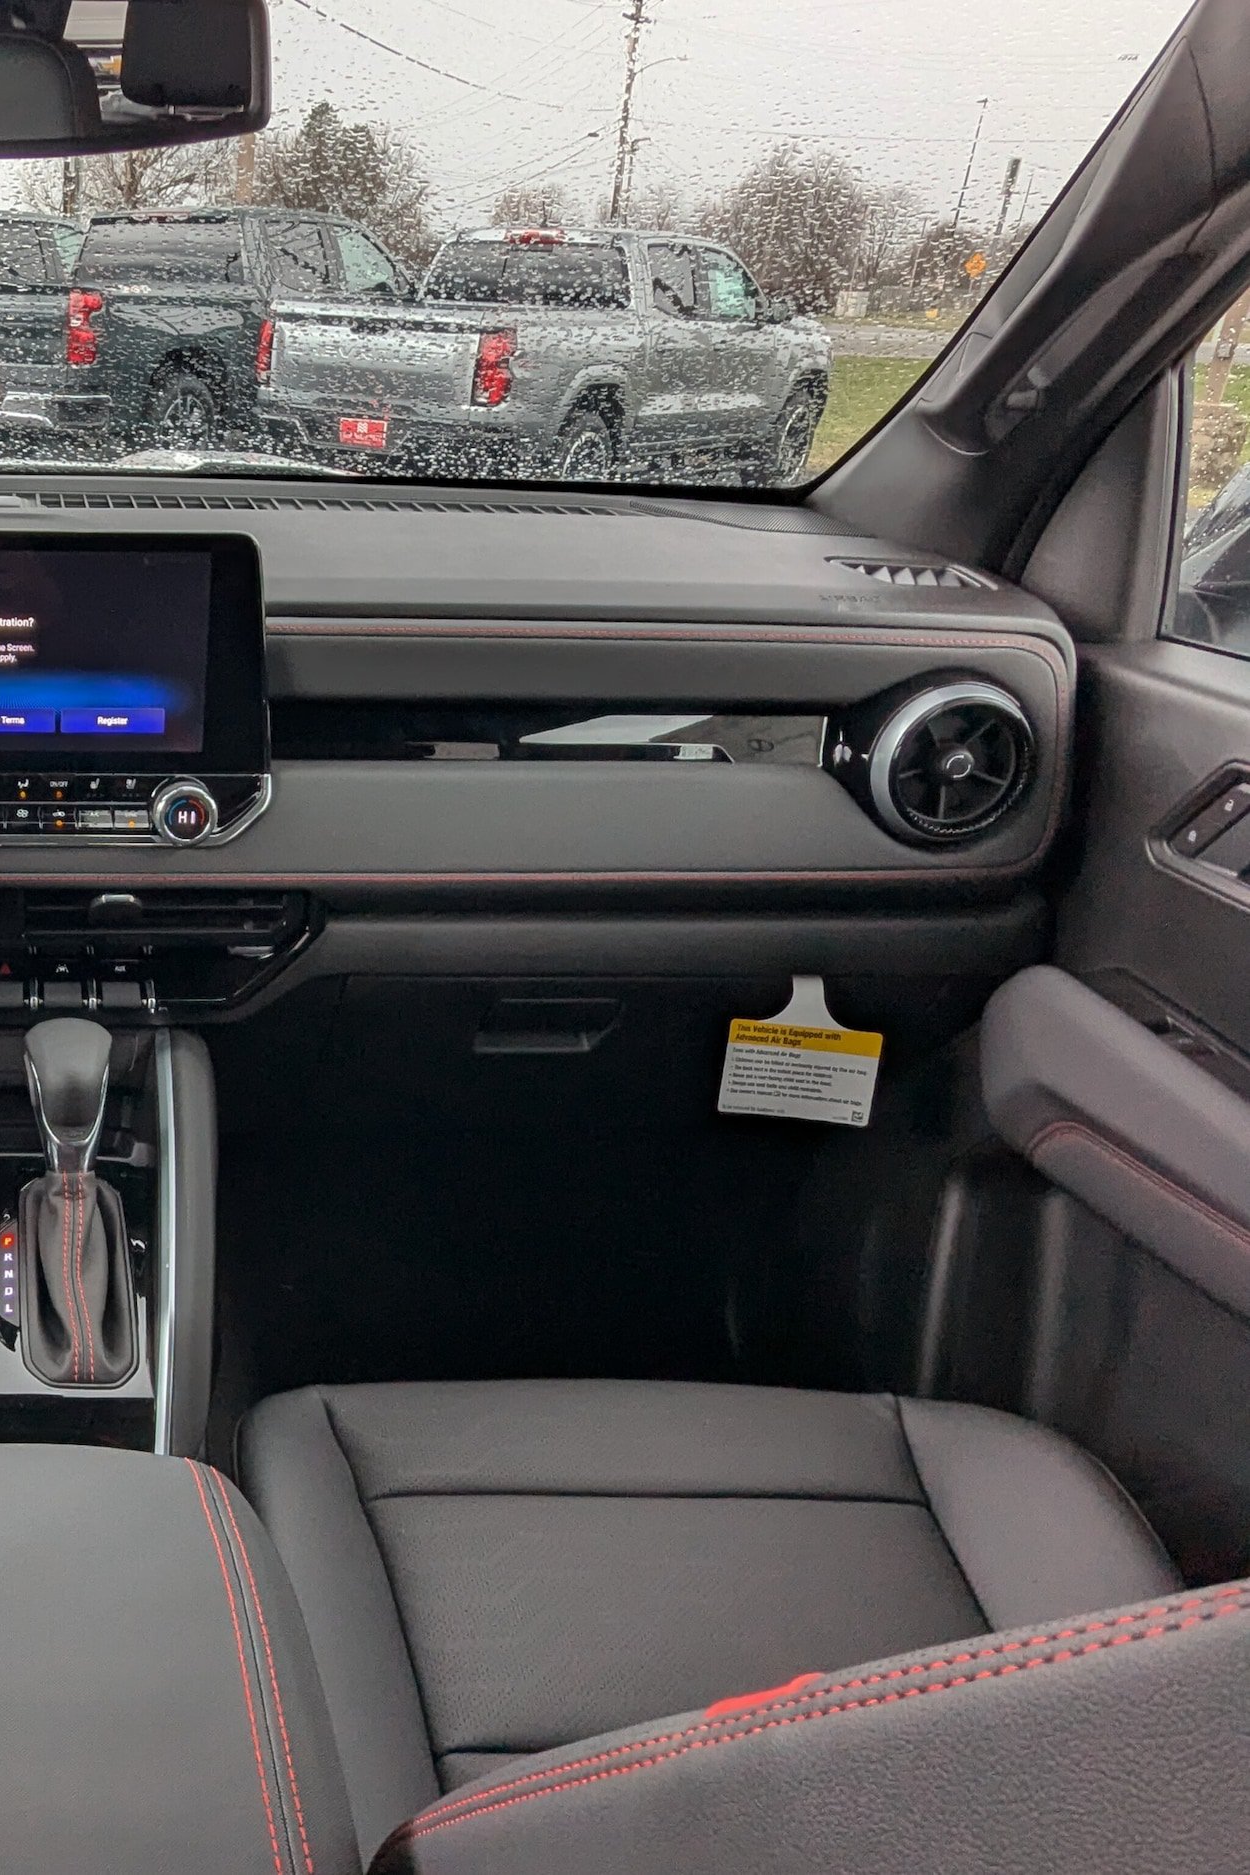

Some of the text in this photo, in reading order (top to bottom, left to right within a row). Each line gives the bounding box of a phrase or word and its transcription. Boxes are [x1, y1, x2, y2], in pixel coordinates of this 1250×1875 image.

[7, 643, 35, 653] Screen.
[0, 716, 25, 725] Terms
[97, 716, 128, 726] Register
[178, 810, 196, 824] HI
[753, 1025, 779, 1035] Vehicle
[789, 1028, 824, 1039] Equipped
[825, 1032, 842, 1041] with
[735, 1033, 802, 1047] Advanced Air Bags
[4, 1237, 12, 1245] P
[4, 1253, 13, 1261] R
[4, 1270, 13, 1278] N
[4, 1287, 13, 1295] D
[5, 1304, 13, 1312] L
